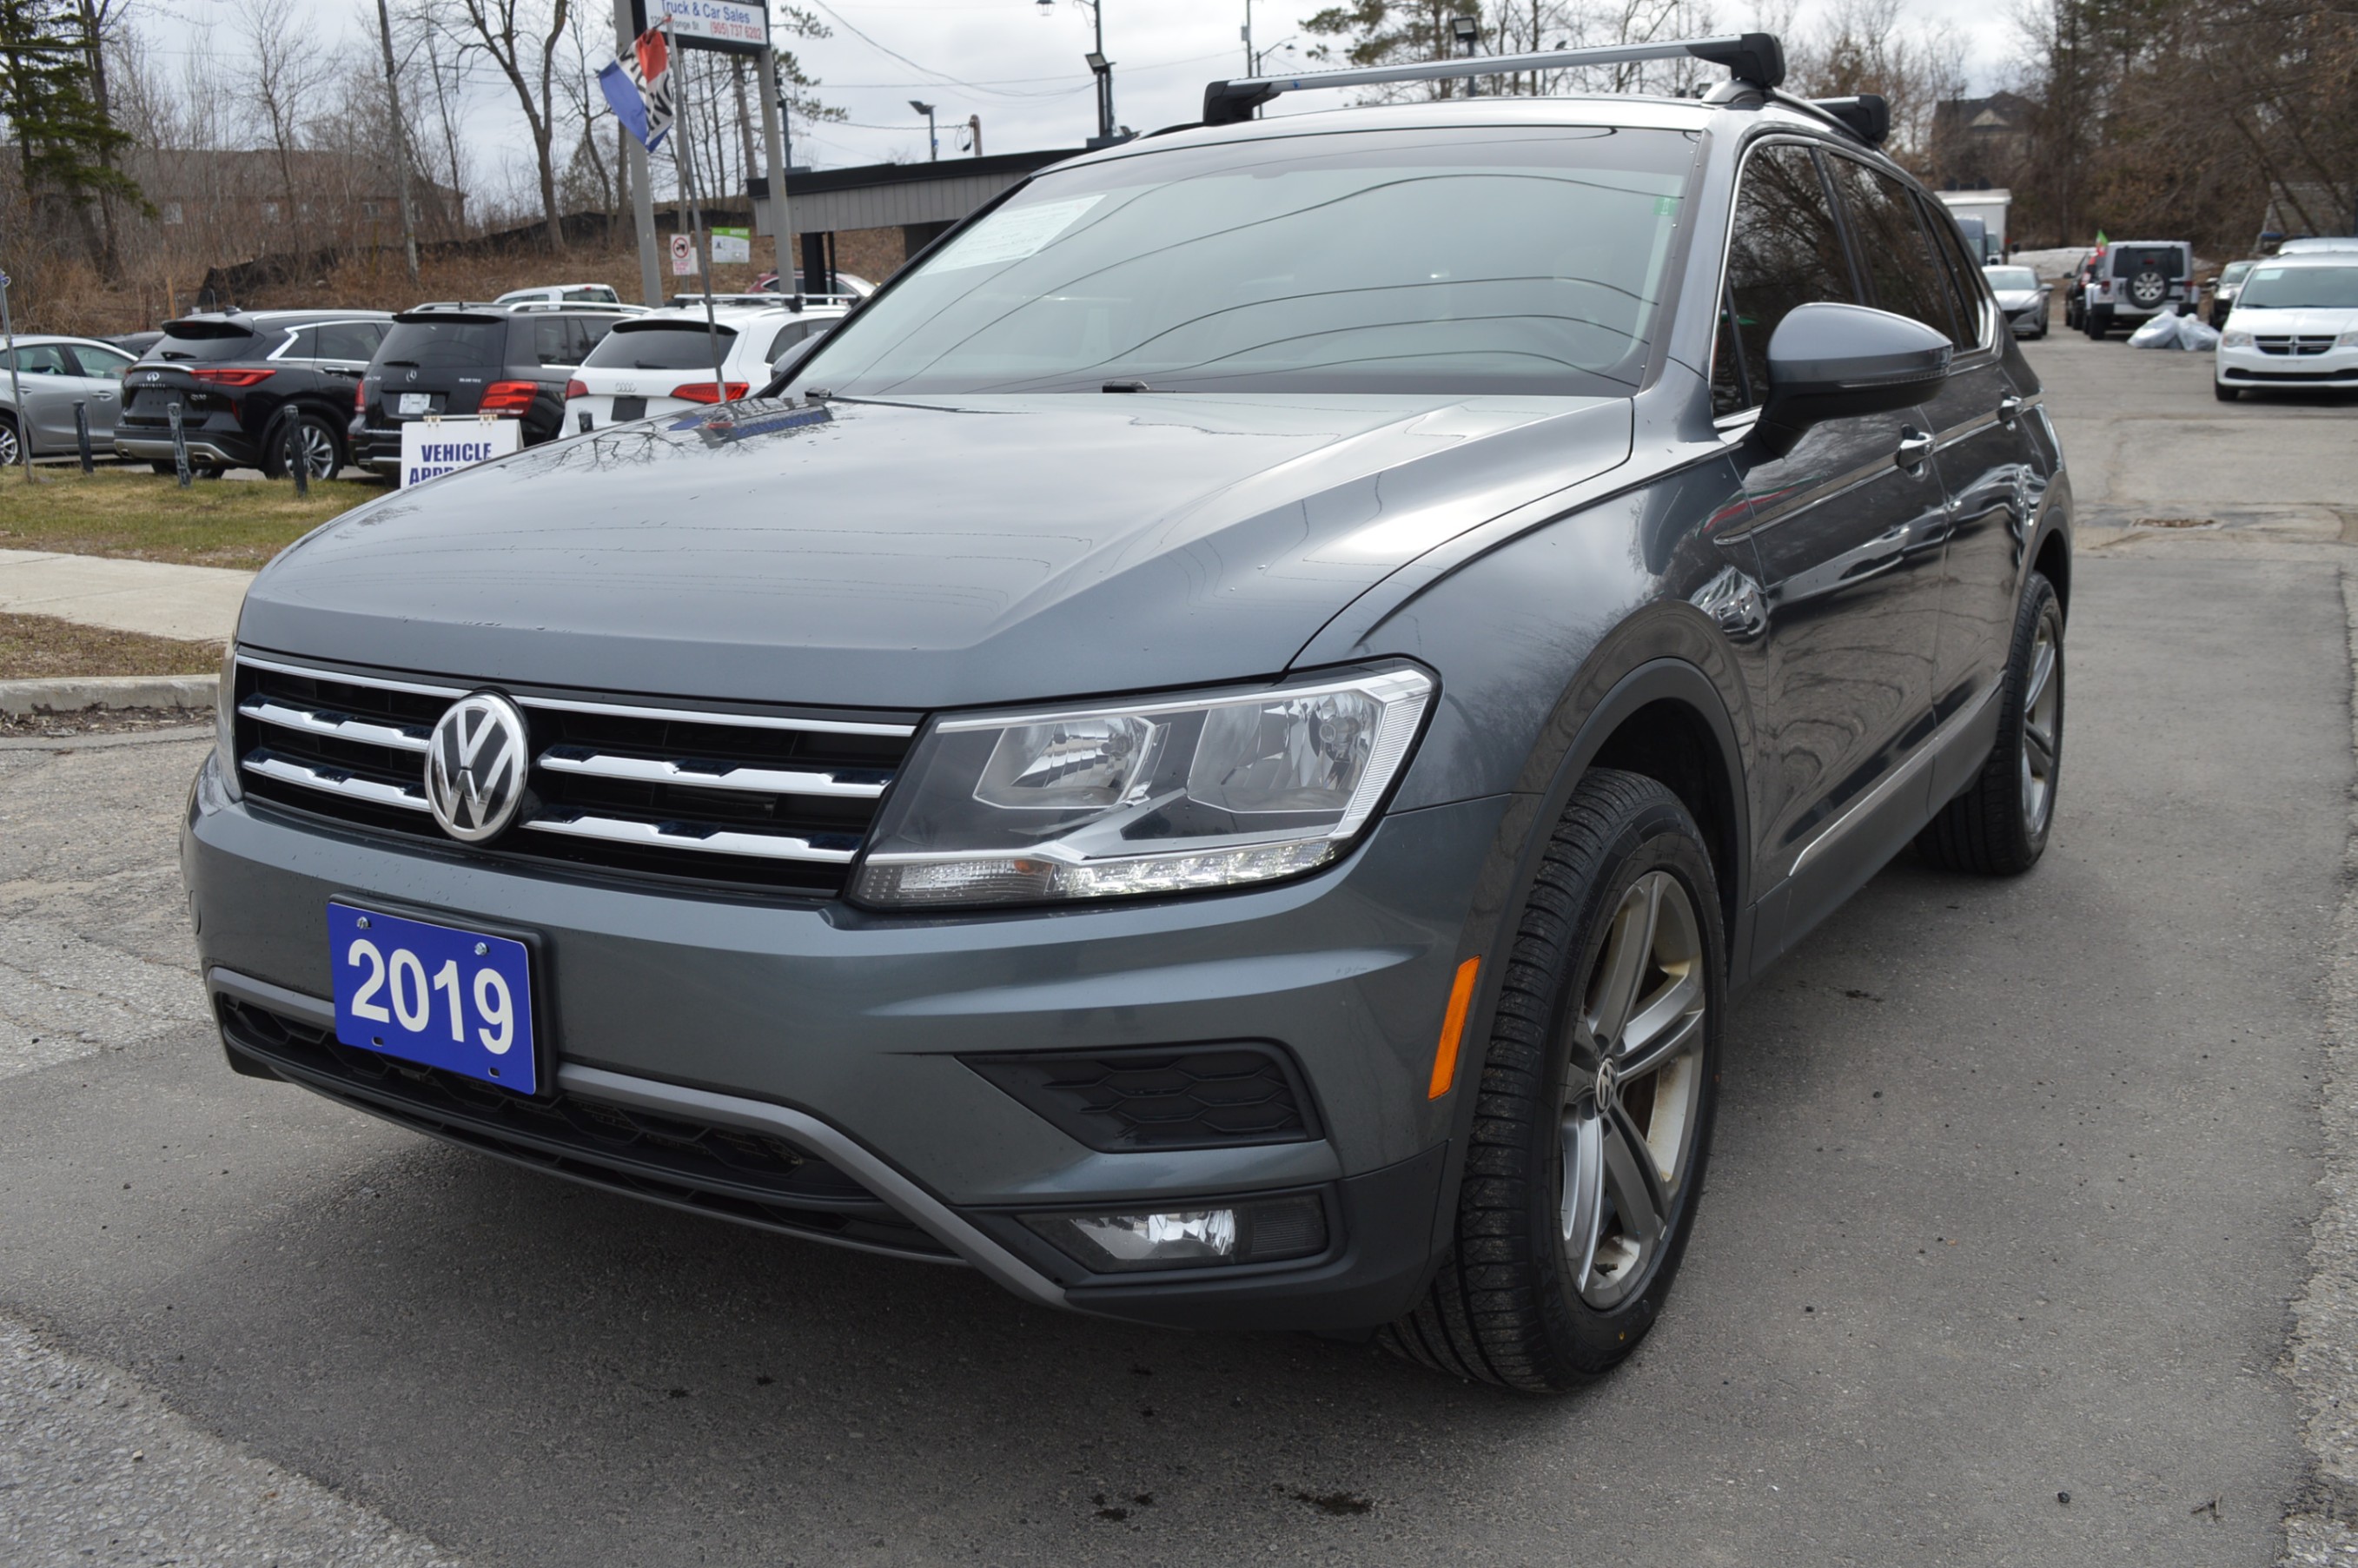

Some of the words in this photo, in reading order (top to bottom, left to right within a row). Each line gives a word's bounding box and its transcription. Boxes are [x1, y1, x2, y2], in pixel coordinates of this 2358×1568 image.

[661, 0, 689, 15] Truck
[692, 2, 700, 16] &
[703, 3, 720, 19] Car
[723, 6, 751, 23] Sales
[710, 21, 729, 39] (905)
[421, 443, 492, 463] VEHICLE
[348, 939, 514, 1055] 2019
